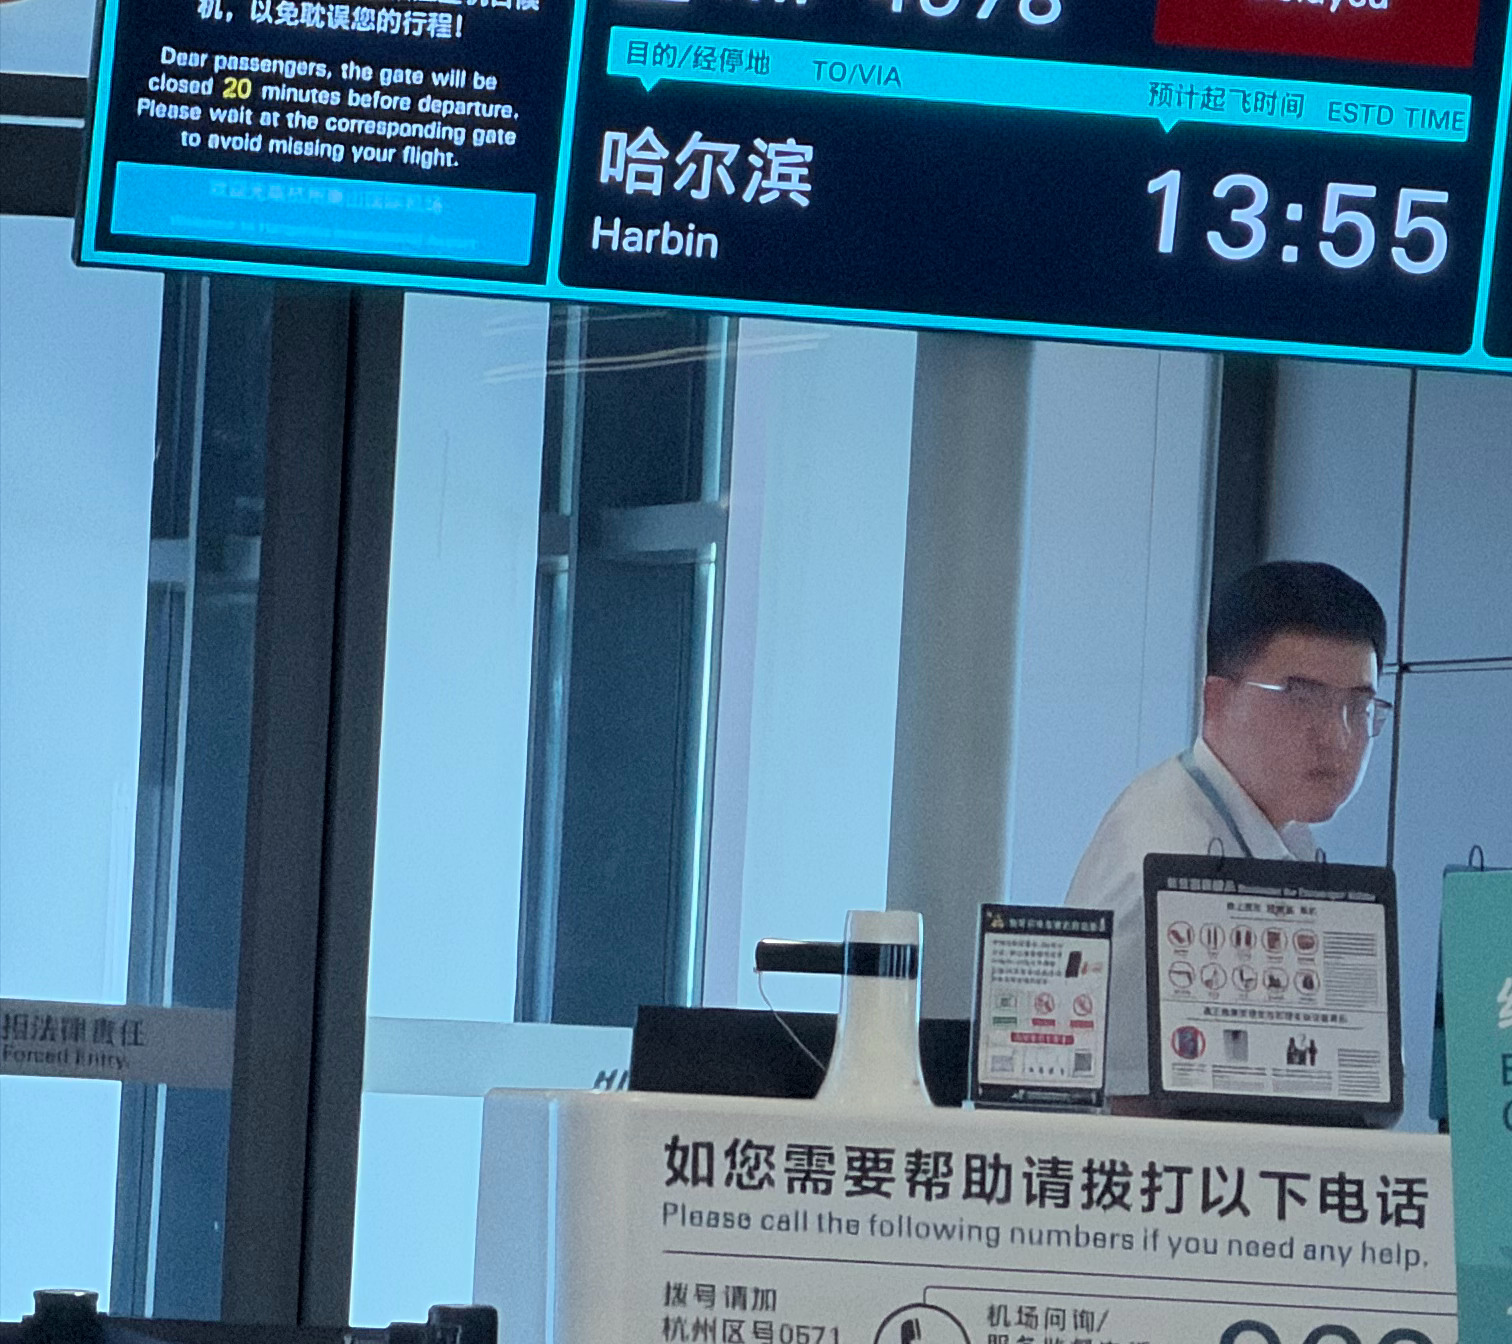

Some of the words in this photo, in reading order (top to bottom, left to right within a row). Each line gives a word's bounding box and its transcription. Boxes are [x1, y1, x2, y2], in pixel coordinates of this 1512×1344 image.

[161, 46, 207, 67] Dear
[214, 52, 333, 80] passengers,
[341, 61, 374, 81] the
[380, 65, 424, 88] gate
[432, 69, 466, 90] will
[473, 71, 498, 91] be
[624, 38, 772, 78] 目的/经停地
[811, 58, 903, 89] TO/VIA
[148, 74, 214, 96] closed
[222, 78, 252, 100] 20
[261, 83, 341, 105] minutes
[347, 88, 411, 110] before
[418, 93, 519, 120] departure.
[1147, 80, 1305, 121] 预计起飞时间
[1327, 101, 1394, 127] ESTD
[1404, 106, 1466, 134] TIME
[137, 98, 201, 121] Please
[209, 104, 253, 126] wait
[260, 109, 280, 127] at
[286, 110, 319, 130] the
[326, 113, 465, 144] corresponding
[472, 124, 517, 147] gate
[181, 130, 201, 147] to
[207, 132, 262, 153] avoid
[268, 136, 345, 162] missing
[351, 145, 397, 166] your
[401, 144, 459, 169] flight.
[598, 127, 814, 211] 哈尔滨
[590, 215, 720, 260] Harbin
[1145, 168, 1450, 276] 13:55
[663, 1134, 1429, 1230] 如您需要帮助请拨打以下电话
[662, 1201, 752, 1231] Please
[761, 1209, 808, 1233] call
[817, 1211, 860, 1236] the
[869, 1212, 1001, 1250] following
[1010, 1222, 1134, 1252] numbers
[1143, 1226, 1160, 1253] if
[1167, 1232, 1219, 1260] you
[1228, 1236, 1294, 1261] need
[1303, 1242, 1353, 1268] any
[663, 1281, 777, 1313] 拨号请加
[986, 1303, 1109, 1334] 机场问询/
